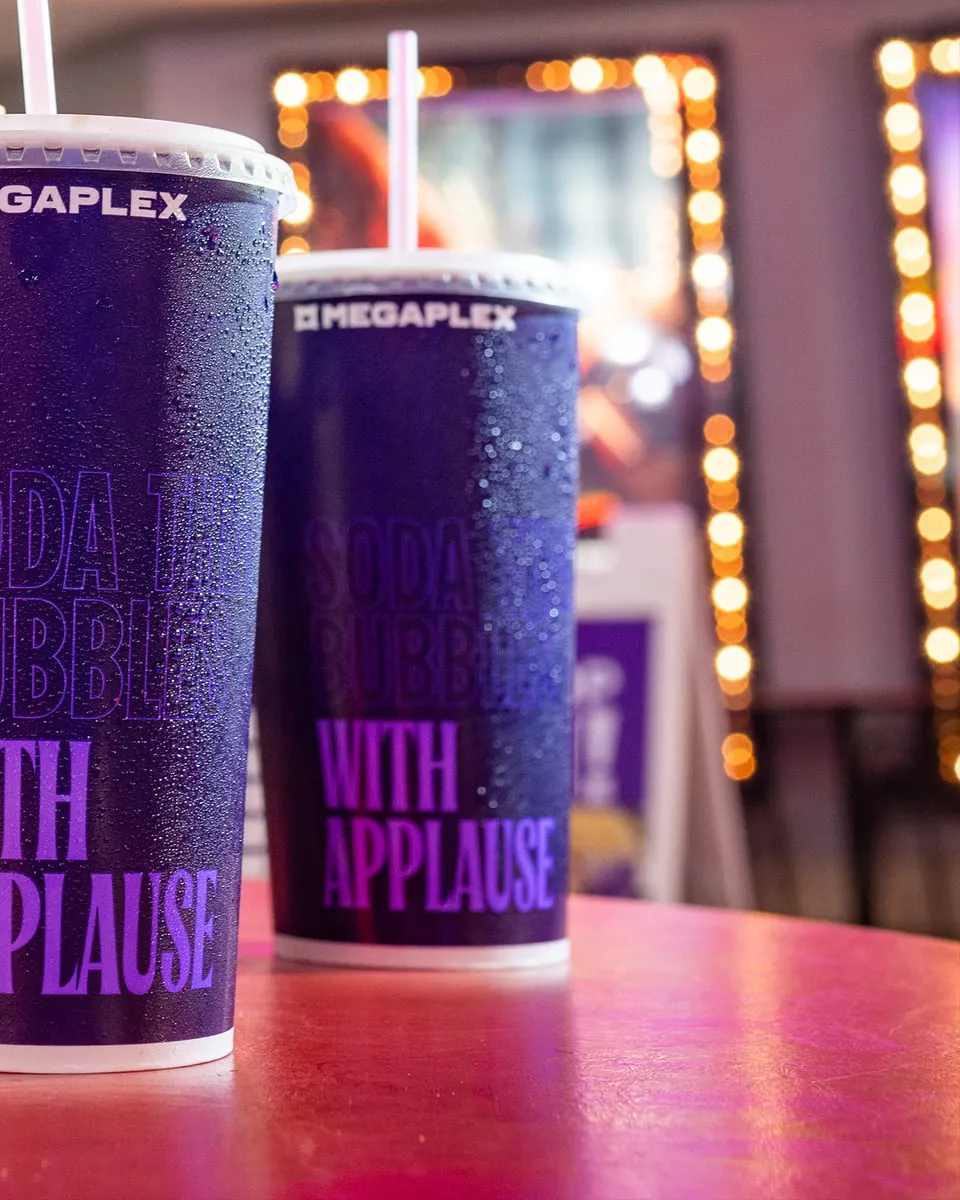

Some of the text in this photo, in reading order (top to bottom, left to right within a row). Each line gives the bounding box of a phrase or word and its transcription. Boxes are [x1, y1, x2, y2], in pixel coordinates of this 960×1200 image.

[321, 301, 518, 332] MEGAPLEX
[316, 719, 458, 814] WITH
[323, 817, 556, 914] APPLAUSE
